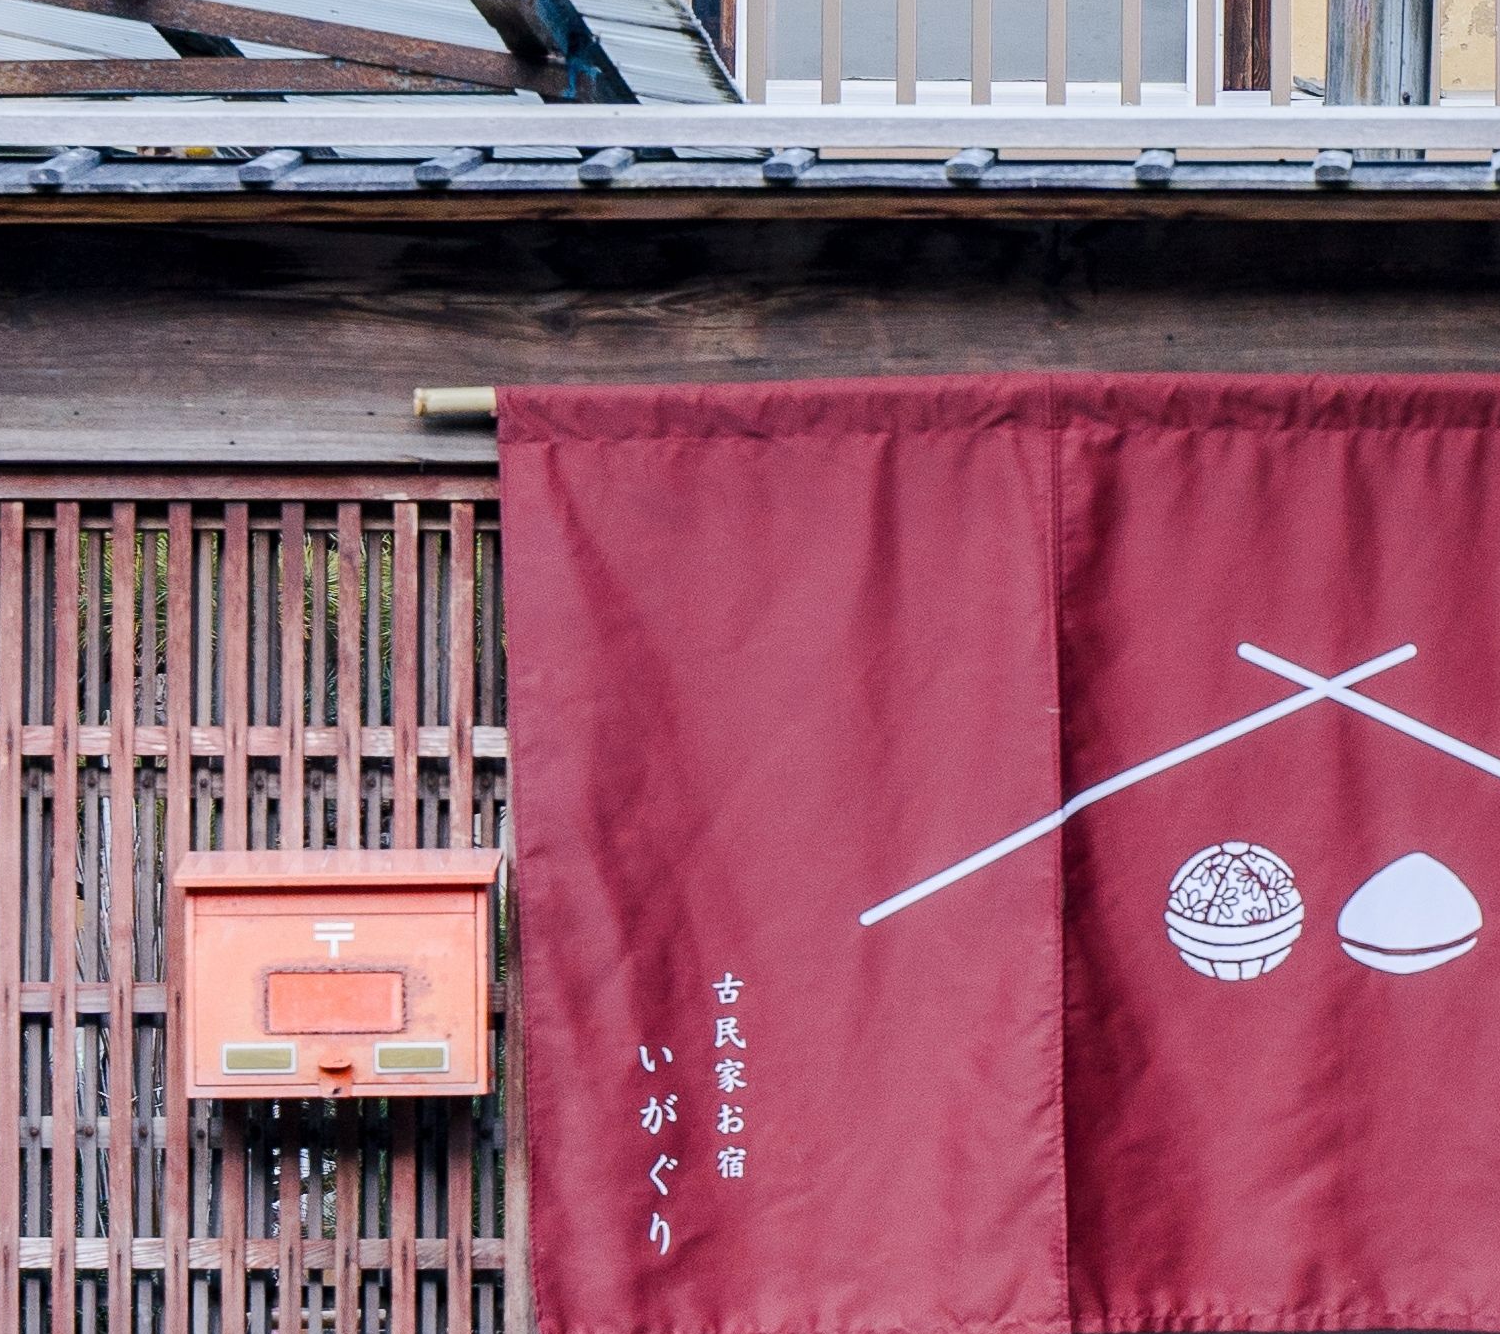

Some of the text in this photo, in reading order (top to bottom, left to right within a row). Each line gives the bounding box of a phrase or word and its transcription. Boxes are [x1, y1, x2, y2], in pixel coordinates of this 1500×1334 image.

[638, 1045, 679, 1255] いがぐり
[712, 972, 748, 1179] 古民家お宿
